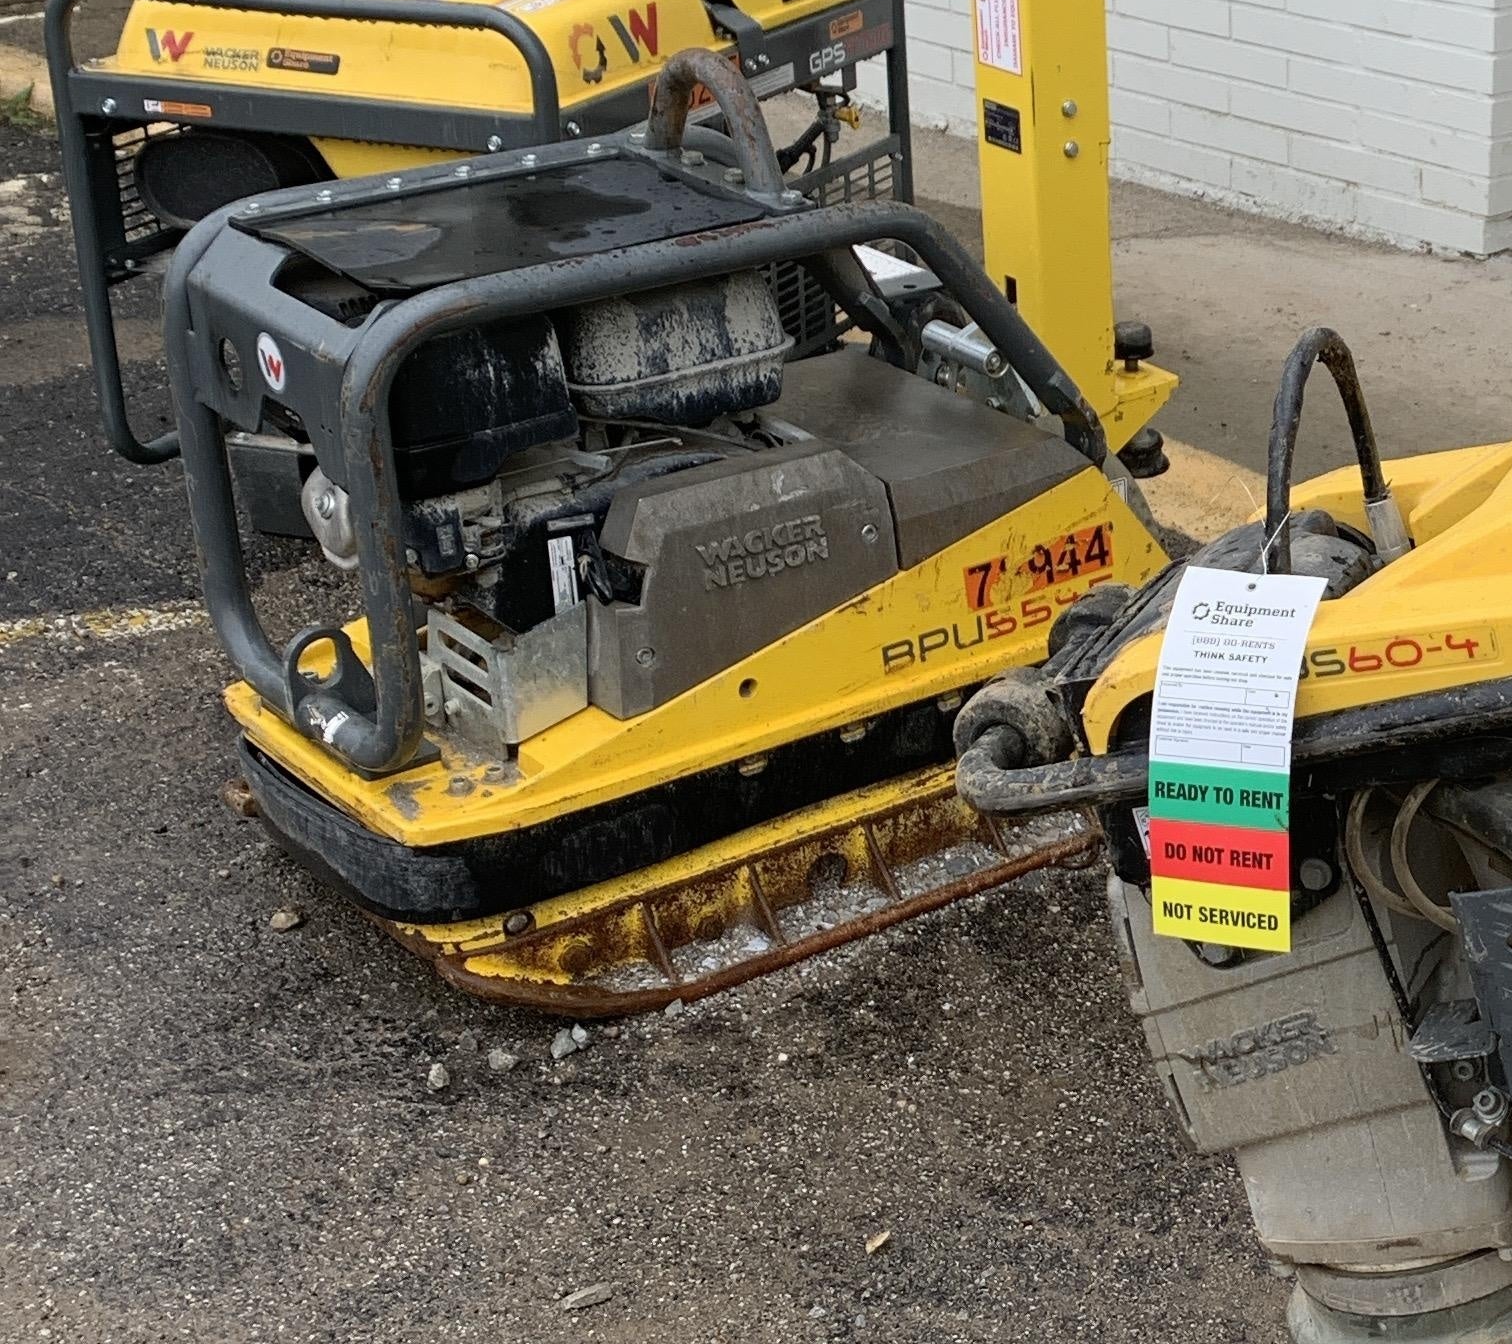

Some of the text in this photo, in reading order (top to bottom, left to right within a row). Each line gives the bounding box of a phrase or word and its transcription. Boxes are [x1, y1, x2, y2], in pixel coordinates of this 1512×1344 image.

[203, 46, 260, 61] WACKER
[203, 57, 260, 72] NEUSON
[694, 513, 827, 567] WACKER
[702, 535, 830, 592] NEUSON
[1210, 613, 1255, 628] Share
[1214, 600, 1297, 619] Equipment
[1192, 649, 1270, 665] THINK SAFETY
[1154, 780, 1285, 811] READY TO RENT
[1163, 841, 1274, 871] DO NOT RENT
[1162, 900, 1279, 932] NOT SERVICED
[1176, 1007, 1328, 1066] WACKER
